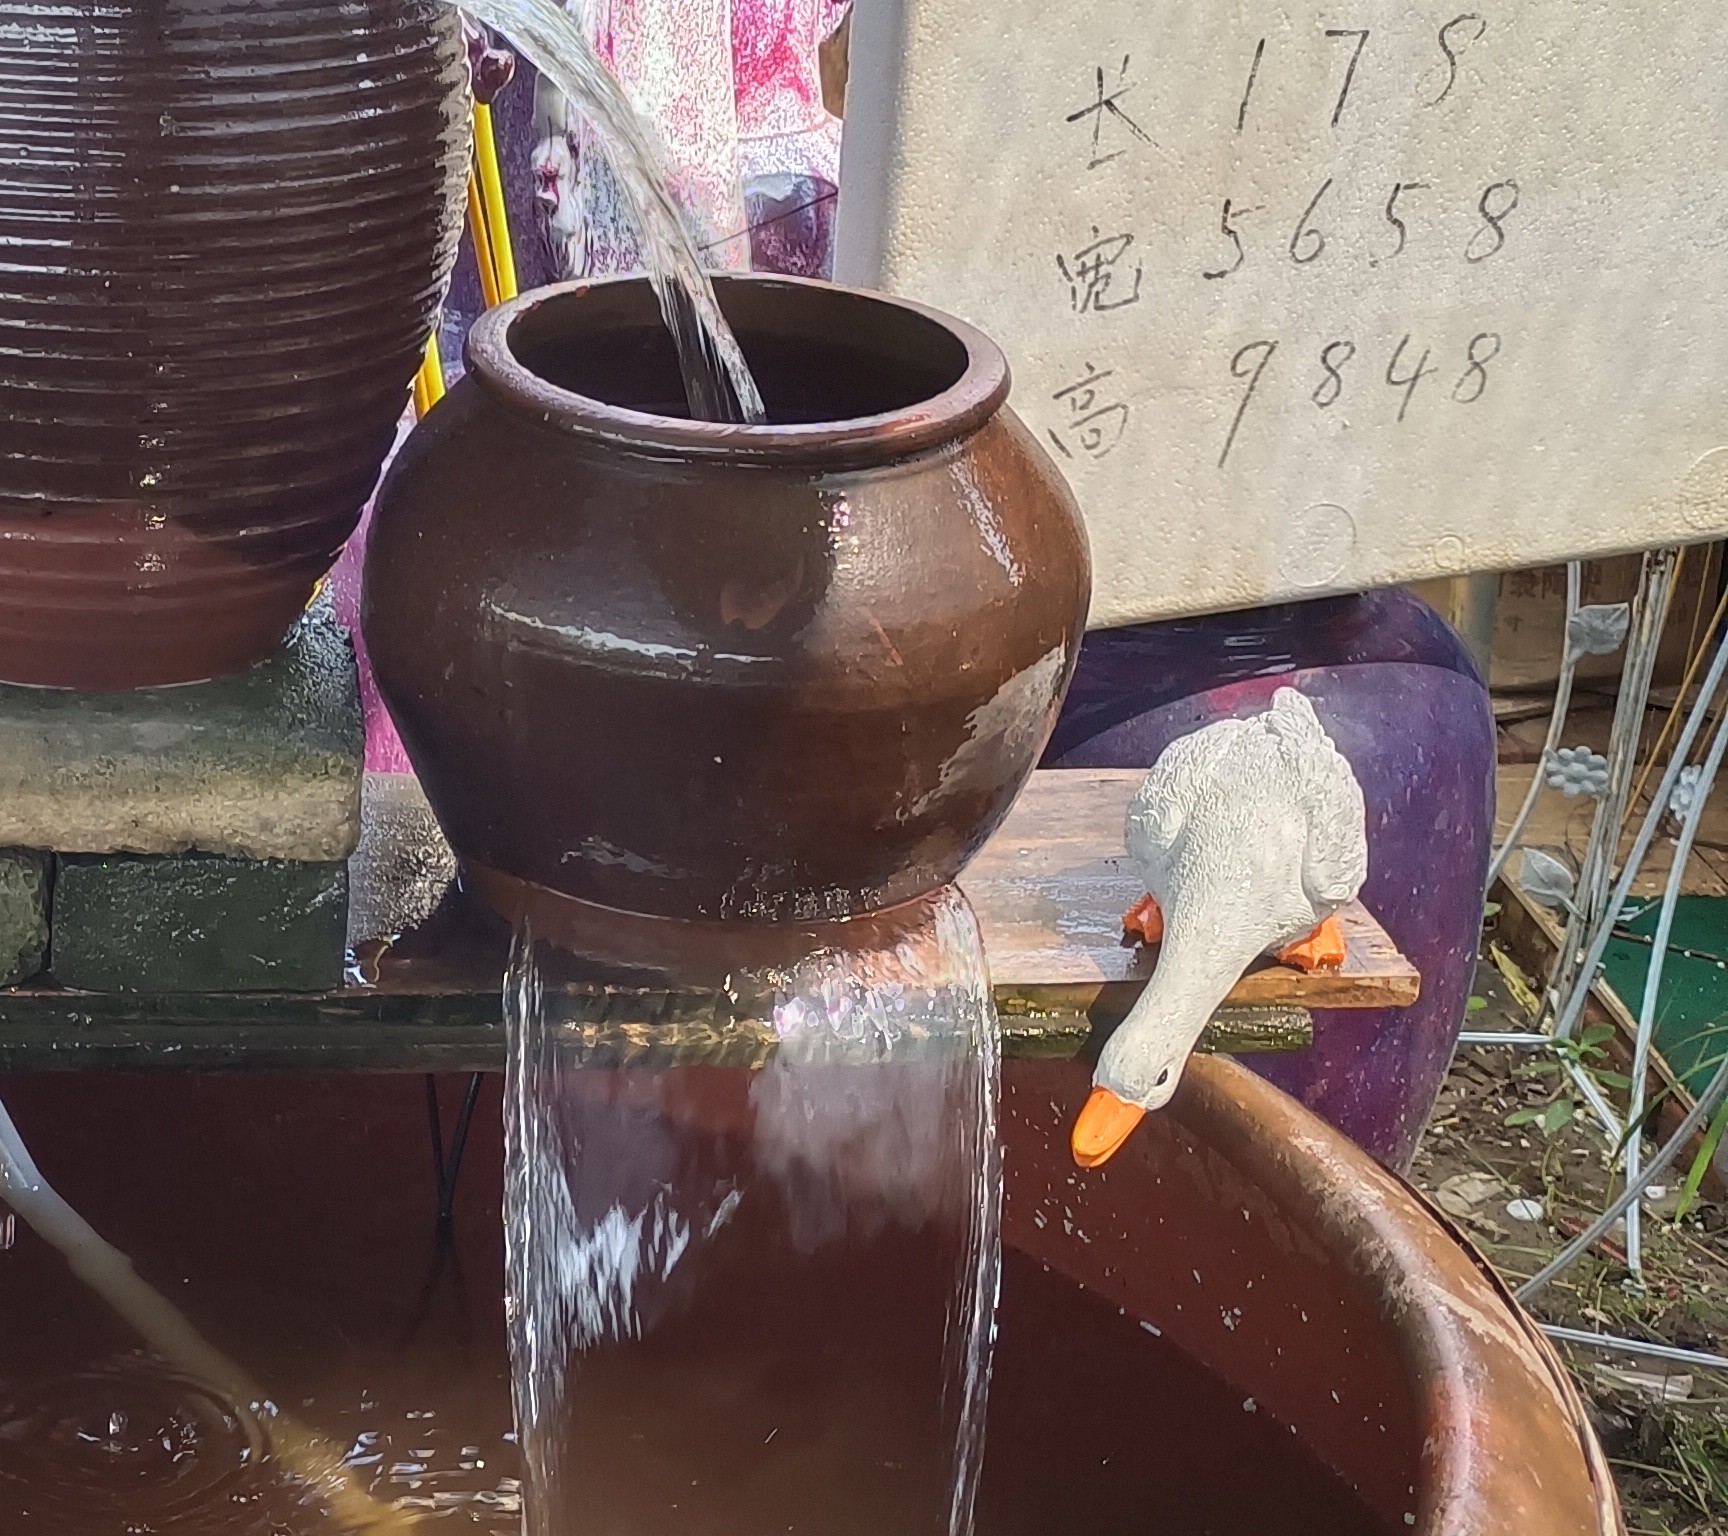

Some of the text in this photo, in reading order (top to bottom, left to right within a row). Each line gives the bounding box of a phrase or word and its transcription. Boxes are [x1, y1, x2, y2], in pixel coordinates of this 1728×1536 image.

[1238, 12, 1487, 130] 178
[1057, 177, 1520, 314] 宽 5658
[1047, 331, 1502, 469] 高 9848
